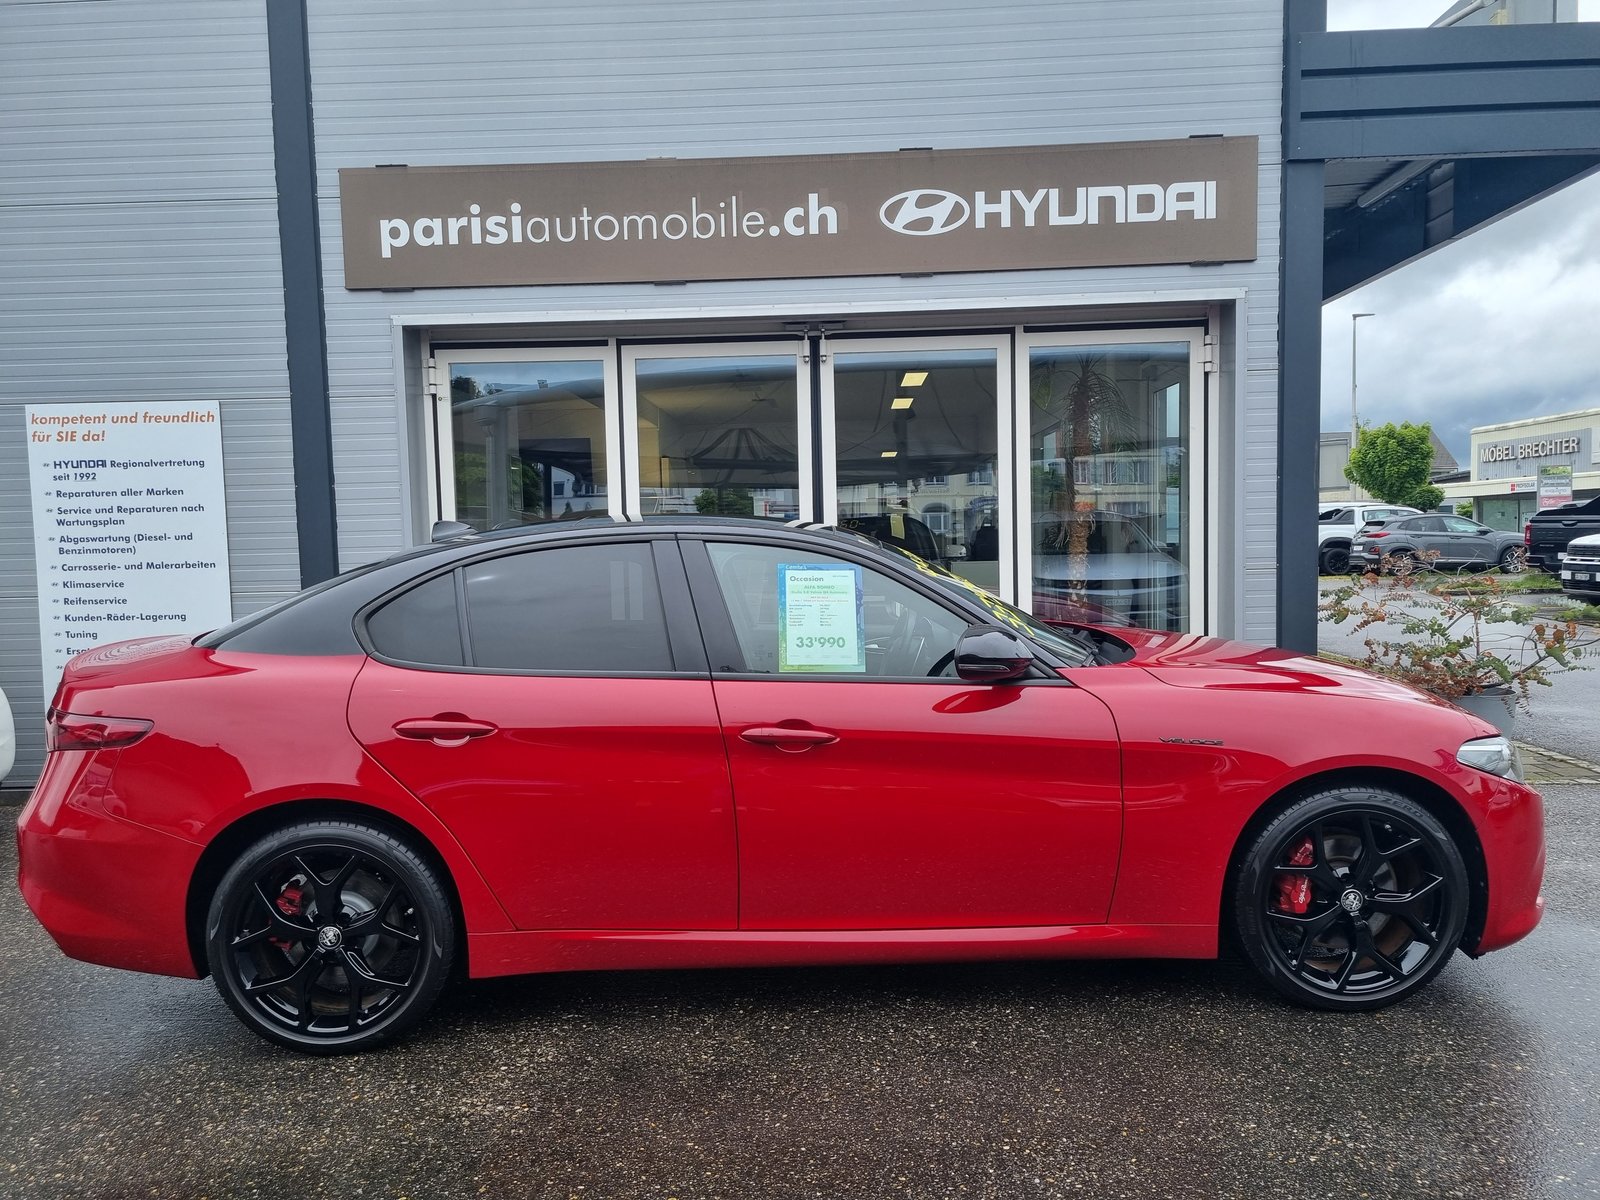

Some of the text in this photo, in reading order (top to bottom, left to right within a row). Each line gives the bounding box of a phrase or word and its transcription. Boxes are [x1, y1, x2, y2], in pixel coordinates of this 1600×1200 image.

[974, 180, 1217, 229] HYUNDAI
[379, 193, 838, 258] parisiautomobile.ch
[31, 410, 215, 426] kompetent und freundlich
[32, 429, 105, 443] für SIE da!
[1480, 437, 1579, 462] MÖBEL BRECHTER
[53, 458, 205, 469] HYUNDAI Regionalvertretung
[53, 472, 97, 481] seit 1992
[56, 487, 184, 500] Reparaturen aller Marken
[57, 503, 205, 516] Service und Reparaturen nach
[56, 517, 125, 530] Wartungsplan
[59, 532, 193, 546] Abgaswartung (Diesel- und
[58, 545, 137, 555] Benzinmotoren)
[61, 560, 216, 572] Carrosserie- und Malerarbeiten
[62, 579, 125, 589] Klimaservice
[63, 596, 128, 606] Reifenservice
[64, 612, 187, 624] Kunden-Räder-Lagerung
[65, 630, 98, 641] Tuning
[796, 636, 846, 648] 33'990
